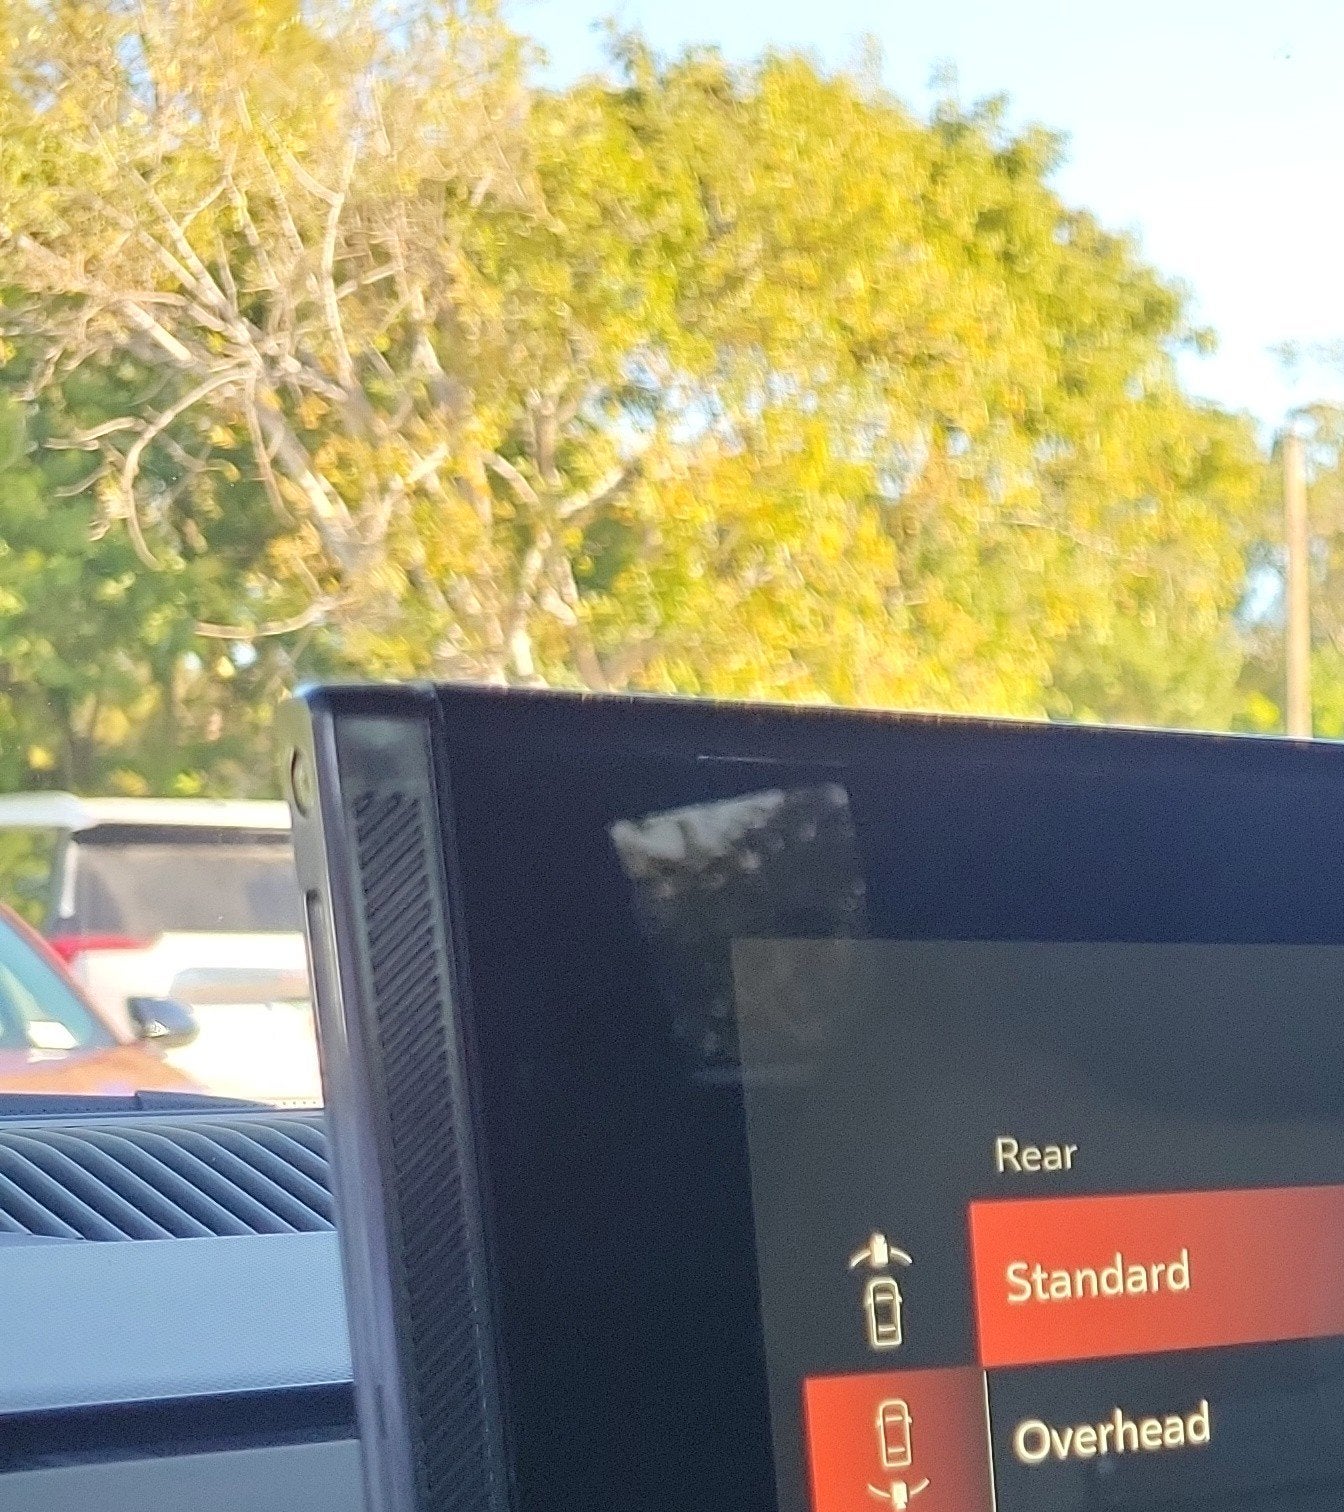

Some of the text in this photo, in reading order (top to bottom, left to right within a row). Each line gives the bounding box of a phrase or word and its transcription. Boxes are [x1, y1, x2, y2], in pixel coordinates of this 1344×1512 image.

[996, 1137, 1078, 1172] Rear
[1005, 1247, 1191, 1305] Standard
[1014, 1400, 1211, 1464] Overhead
